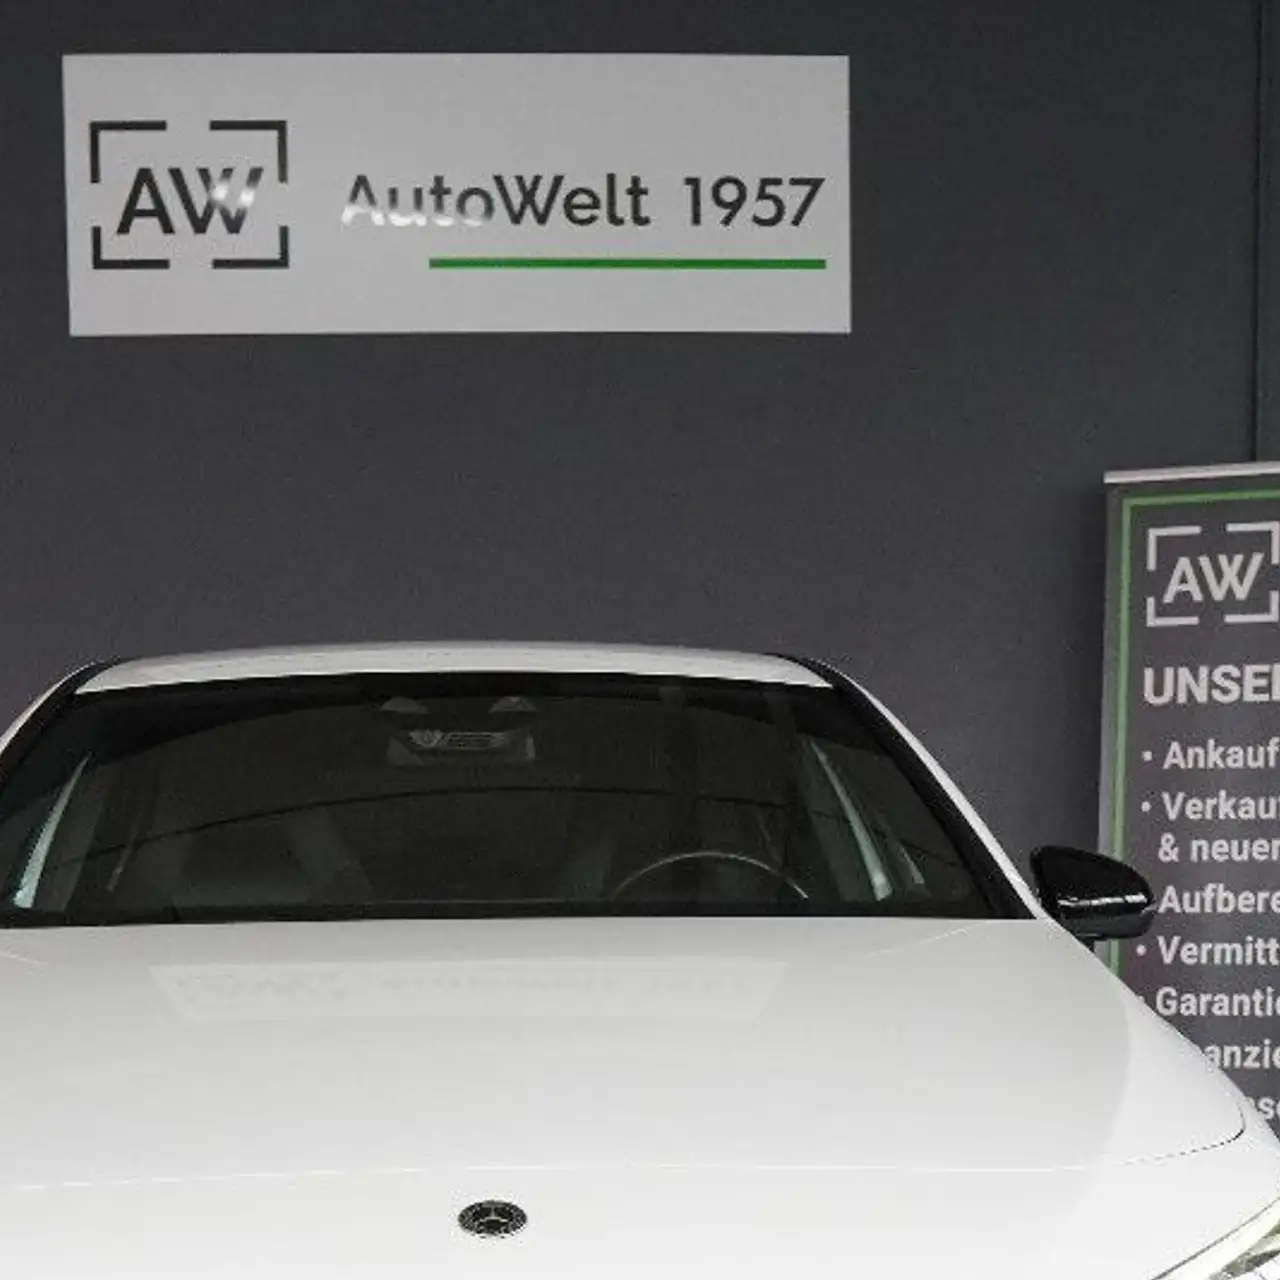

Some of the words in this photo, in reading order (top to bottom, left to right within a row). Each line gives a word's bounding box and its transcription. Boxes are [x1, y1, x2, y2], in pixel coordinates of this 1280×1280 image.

[117, 166, 264, 235] AW
[341, 173, 652, 228] AutoWelt
[683, 177, 826, 226] 1957
[1162, 551, 1264, 604] AW
[1162, 737, 1280, 770] Ankauf
[1158, 833, 1180, 862] &
